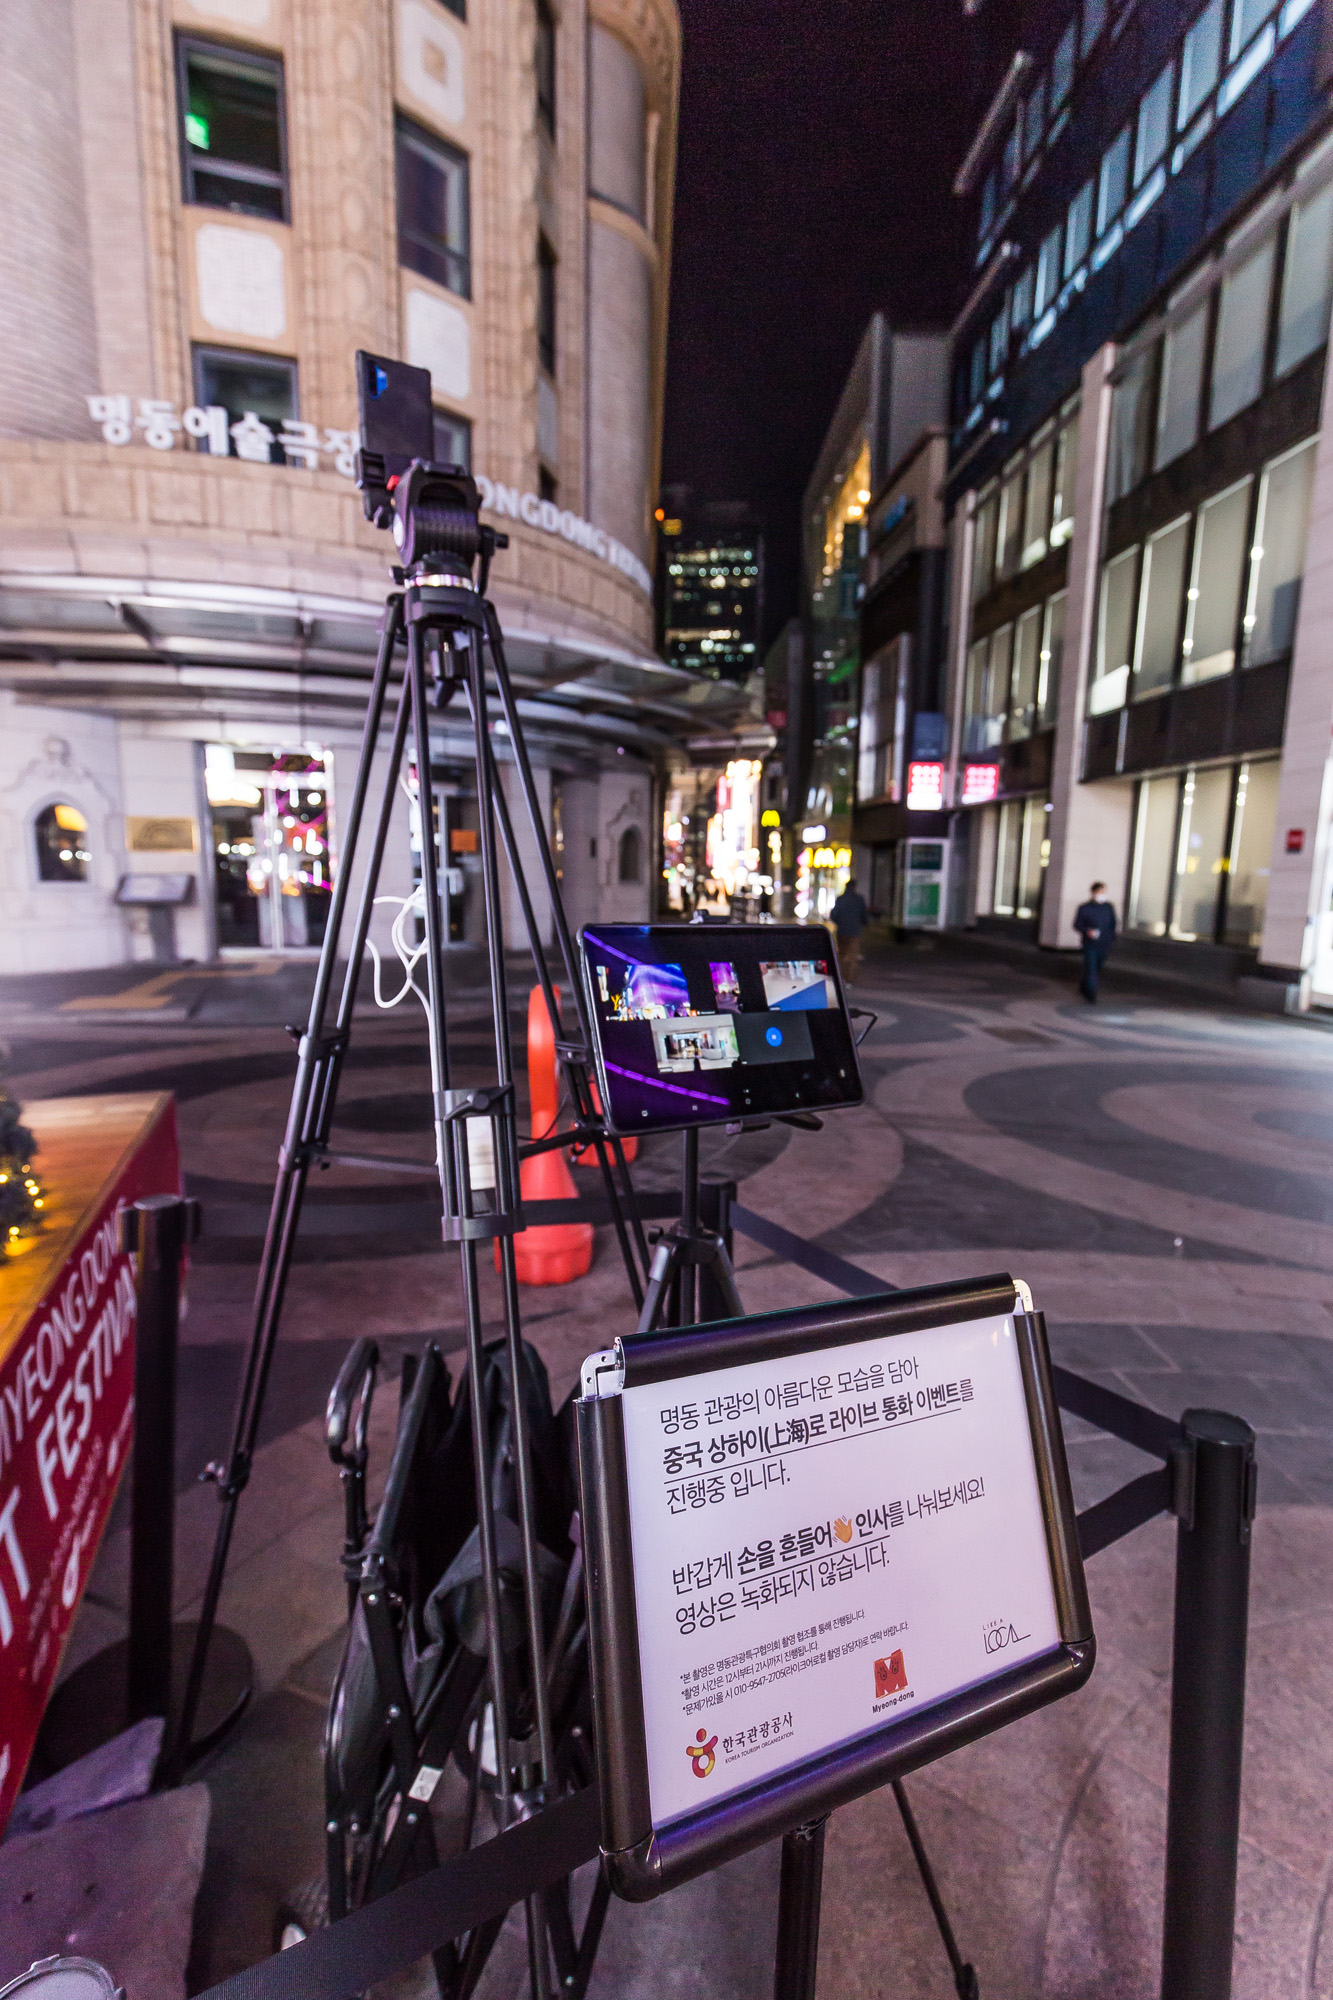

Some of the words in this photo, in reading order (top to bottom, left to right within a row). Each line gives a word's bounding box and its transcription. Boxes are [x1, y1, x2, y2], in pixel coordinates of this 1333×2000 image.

[84, 394, 361, 477] 명동예술극장
[0, 1196, 126, 1465] YEONGDON
[36, 1250, 138, 1521] FESTIVA
[660, 1403, 700, 1434] 명동
[704, 1389, 760, 1425] 관광의
[764, 1375, 834, 1410] 아름다운
[838, 1364, 885, 1393] 모습을
[888, 1356, 919, 1384] 담아
[663, 1441, 704, 1474] 중국
[707, 1413, 827, 1464] 상하이(上海)로
[829, 1401, 879, 1432] 라이브
[882, 1391, 914, 1421] 통화
[916, 1378, 974, 1411] 이벤트를
[666, 1475, 726, 1515] 진행중
[730, 1459, 791, 1498] 입니다.
[672, 1551, 733, 1595] 반갑게
[737, 1540, 775, 1575] 손을
[779, 1521, 833, 1562] 흔들어
[855, 1500, 904, 1537] 인사를
[907, 1476, 985, 1519] 나눠보세요!
[675, 1592, 737, 1635] 영상은
[741, 1565, 815, 1610] 녹화되지
[818, 1541, 890, 1587] 않습니다.
[692, 1663, 715, 1681] 촬영은
[716, 1639, 781, 1672] 명동관광특구협의회
[781, 1633, 796, 1648] 촬영
[796, 1626, 817, 1642] 협조를
[818, 1620, 832, 1635] 통해
[982, 1620, 997, 1631] LIKE
[701, 1675, 724, 1692] 시간은
[725, 1664, 754, 1684] 12시부터
[755, 1654, 783, 1673] 21시까지
[725, 1687, 733, 1699] 시
[827, 1646, 841, 1661] 촬영
[869, 1630, 883, 1644] 연락
[722, 1711, 793, 1754] 한국관광공사
[872, 1690, 915, 1714] Myeong-dong
[725, 1754, 740, 1764] KOREA
[741, 1745, 761, 1760] TOURISM
[761, 1731, 794, 1749] ORGANIZATION
